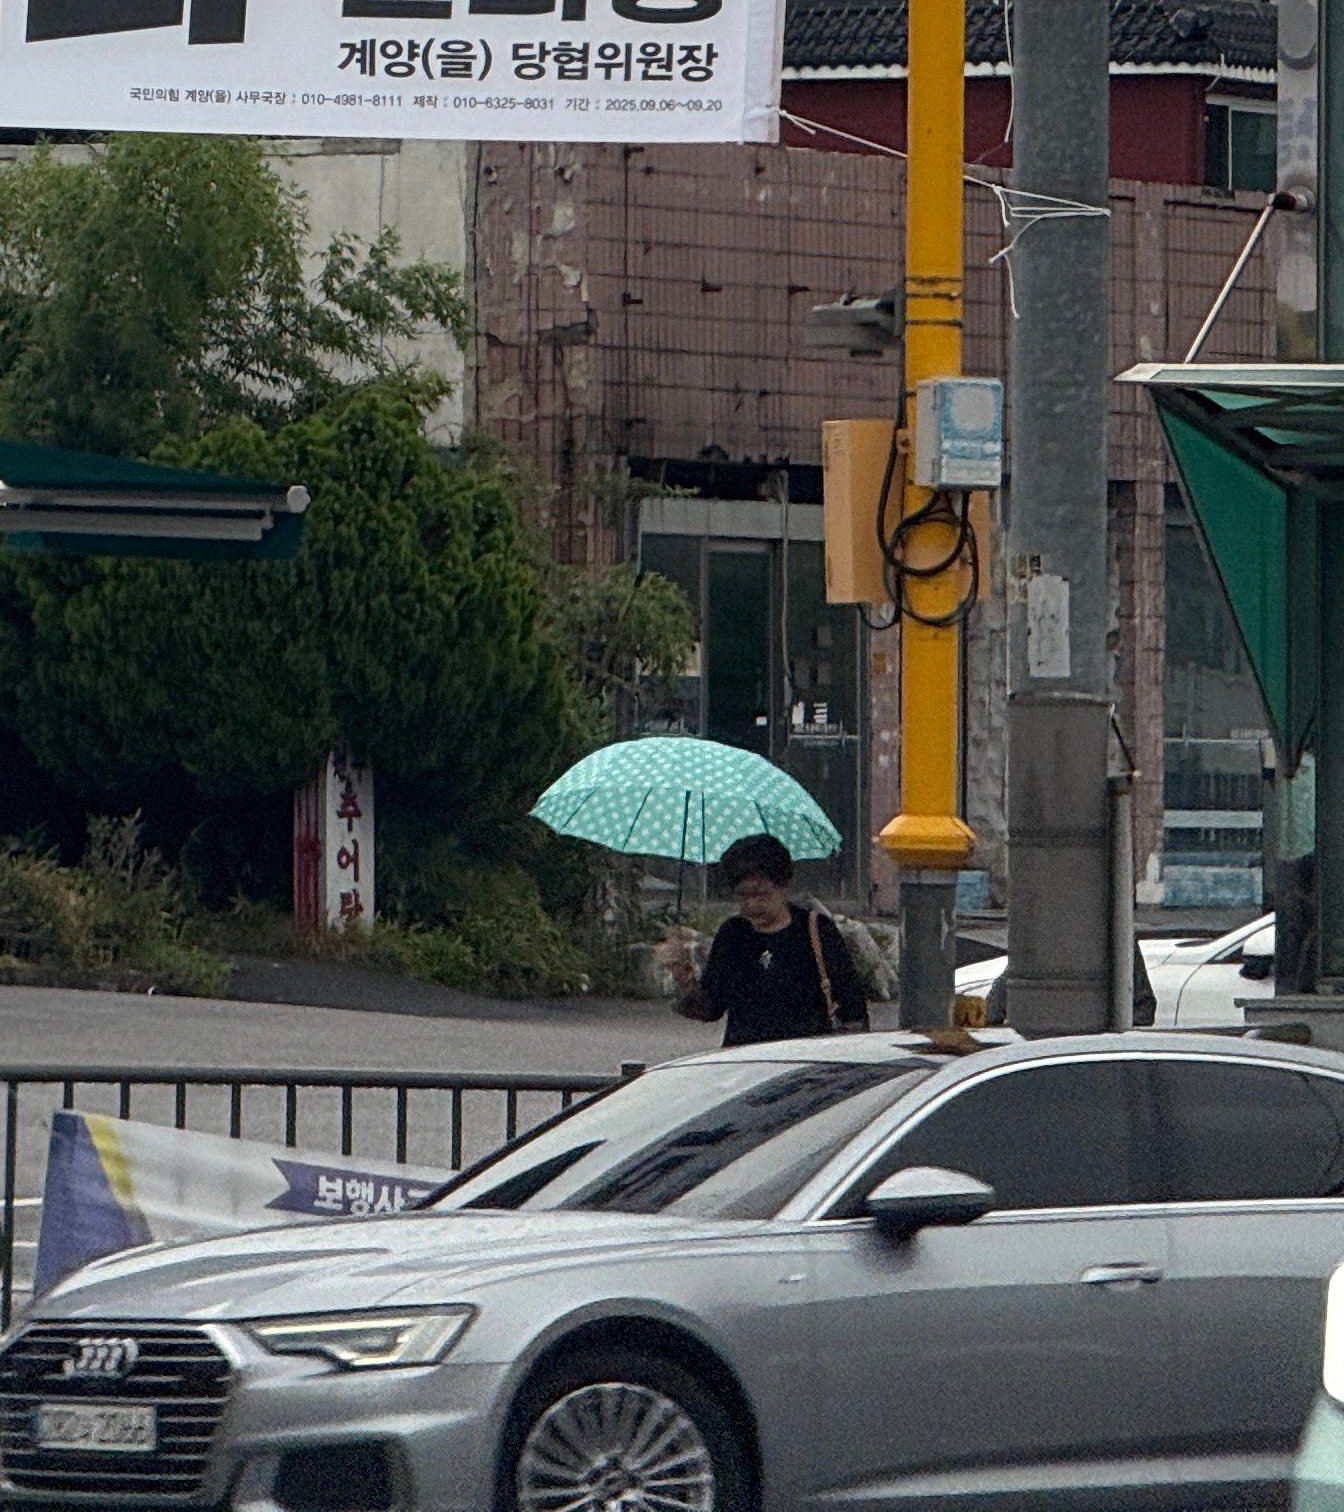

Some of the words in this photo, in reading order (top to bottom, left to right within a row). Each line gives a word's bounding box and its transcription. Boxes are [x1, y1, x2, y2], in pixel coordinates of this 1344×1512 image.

[336, 37, 494, 81] 계양(을)
[510, 40, 720, 83] 당협위원장
[128, 87, 180, 103] 국민의힘
[184, 89, 232, 105] 계양(을)
[235, 91, 287, 106] 사무국장
[300, 93, 403, 108] 010-4981-8111
[412, 95, 439, 110] 제작
[565, 97, 591, 113] 기간
